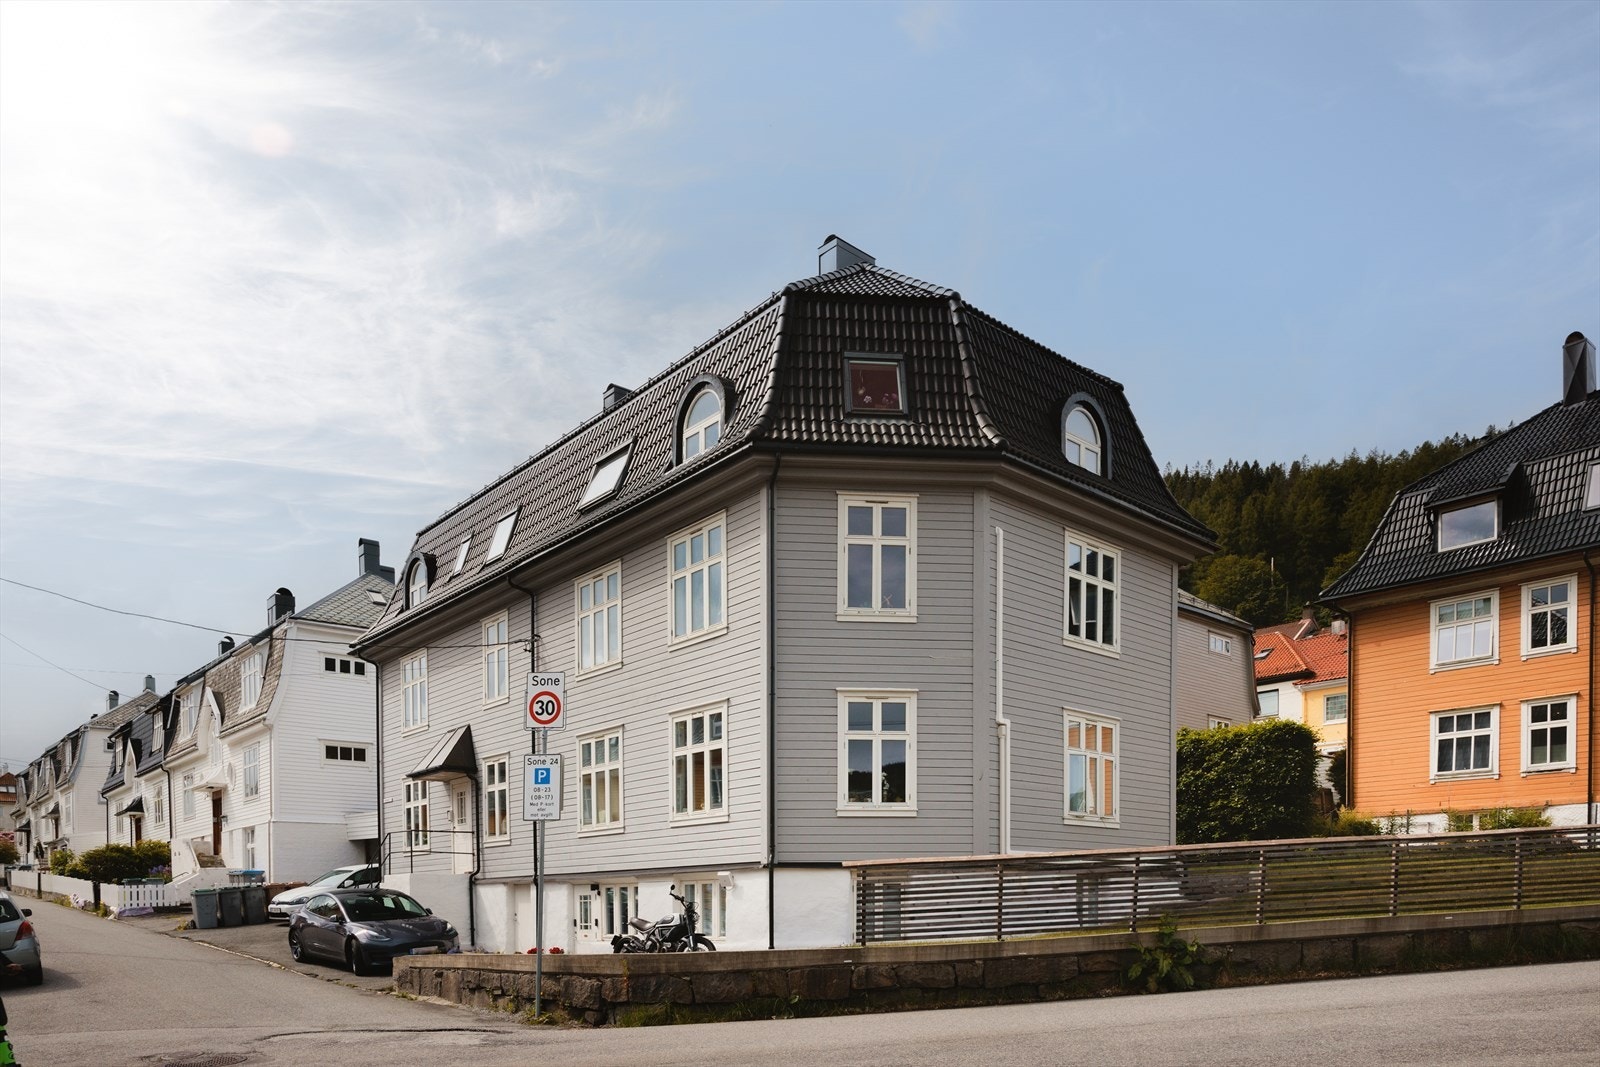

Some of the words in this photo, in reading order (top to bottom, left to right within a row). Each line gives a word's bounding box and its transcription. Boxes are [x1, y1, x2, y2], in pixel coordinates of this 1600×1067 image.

[532, 675, 560, 687] Sone
[535, 700, 555, 716] 30
[527, 758, 547, 766] Sone
[538, 770, 547, 783] P
